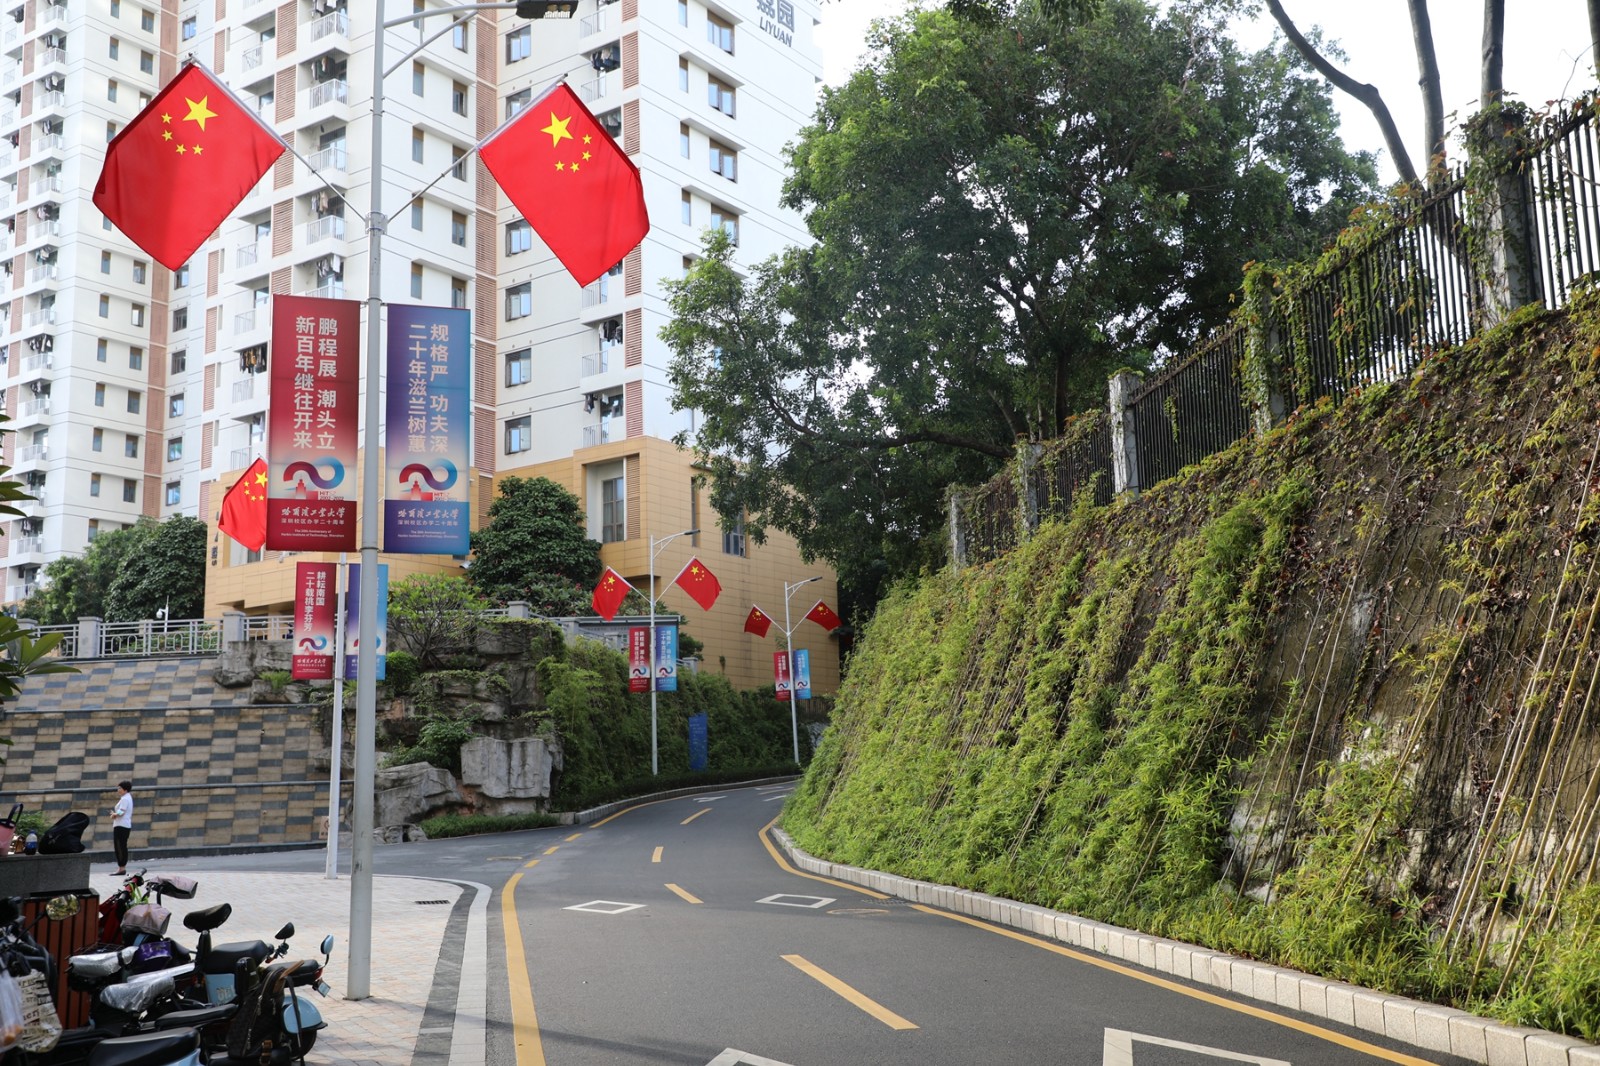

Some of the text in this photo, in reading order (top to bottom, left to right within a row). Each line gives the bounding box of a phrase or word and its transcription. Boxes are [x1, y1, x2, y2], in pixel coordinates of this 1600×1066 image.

[759, 16, 793, 48] LIYUAN
[293, 315, 316, 450] 新百年继往开来
[316, 317, 338, 450] 鹏程展 潮头立
[408, 324, 427, 453] 二十年滋兰树蕙
[430, 324, 449, 453] 规格严 功夫深
[303, 571, 315, 632] 二十载桃李芬芳
[315, 571, 326, 606] 耕耘南国
